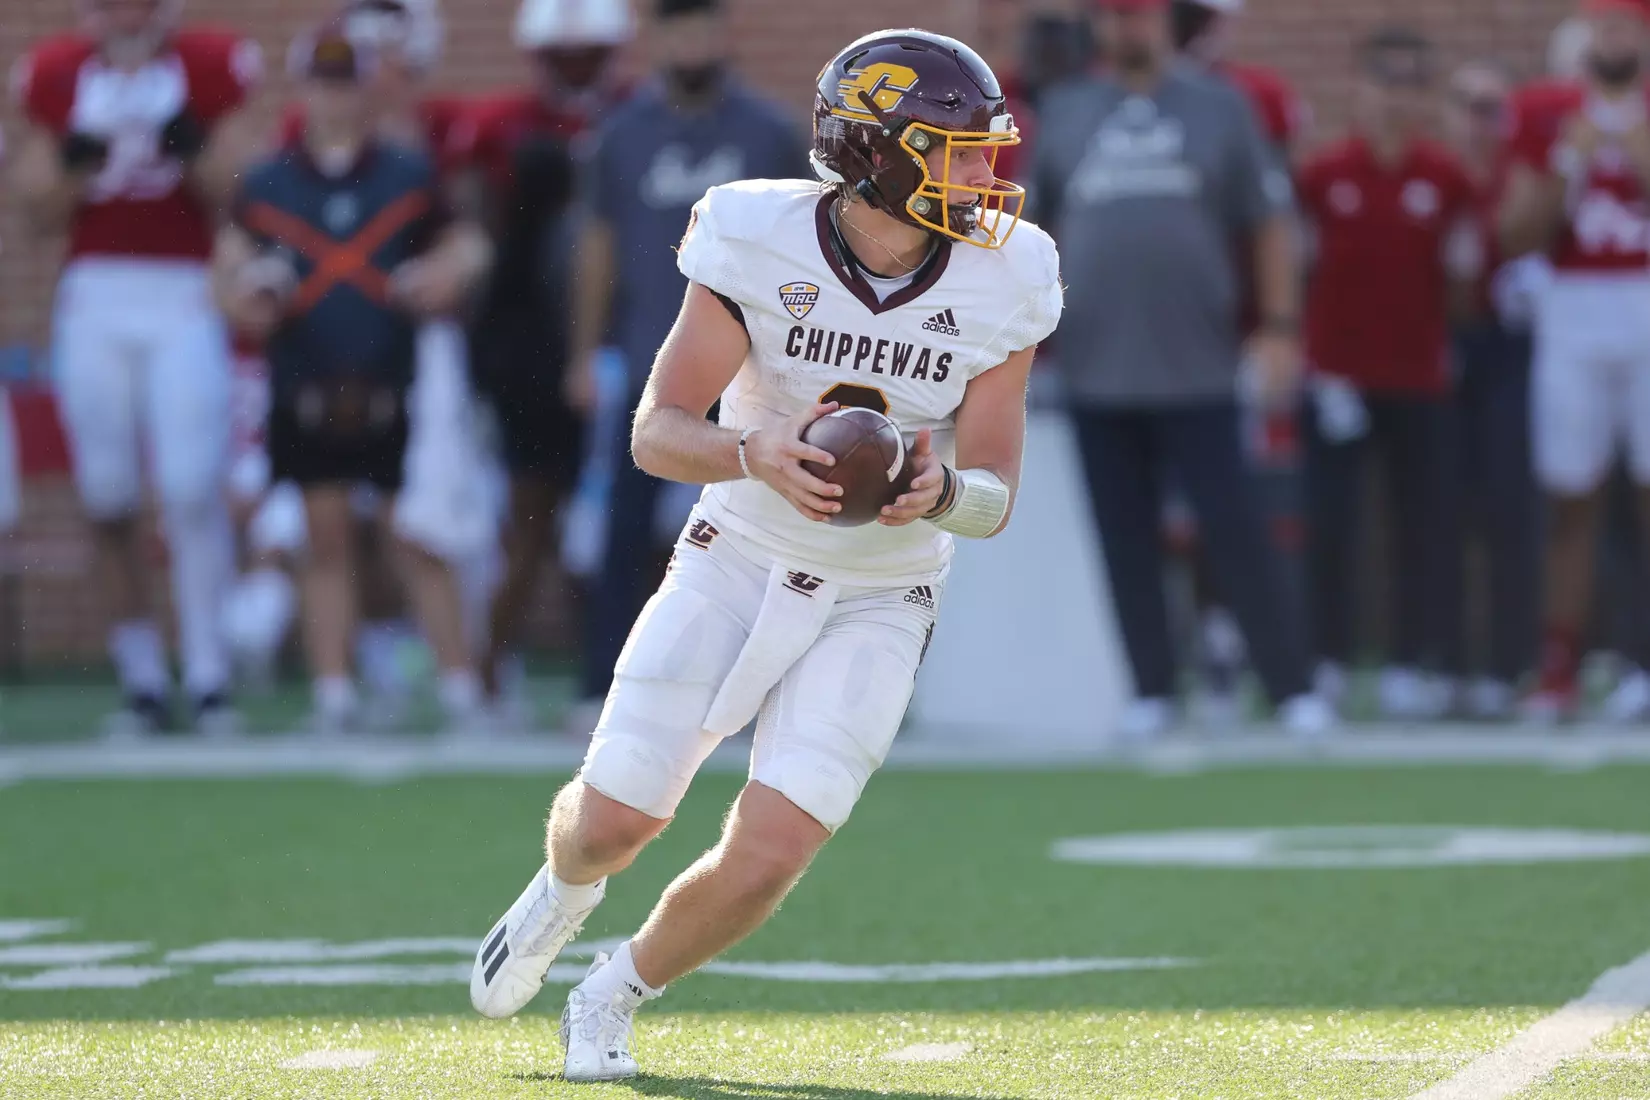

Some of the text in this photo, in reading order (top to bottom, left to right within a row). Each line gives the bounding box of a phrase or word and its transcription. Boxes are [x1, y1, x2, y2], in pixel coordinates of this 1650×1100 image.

[782, 293, 818, 305] MAC
[921, 320, 961, 337] adidas
[785, 325, 954, 383] CHIPPEWAS
[903, 592, 935, 609] adidas
